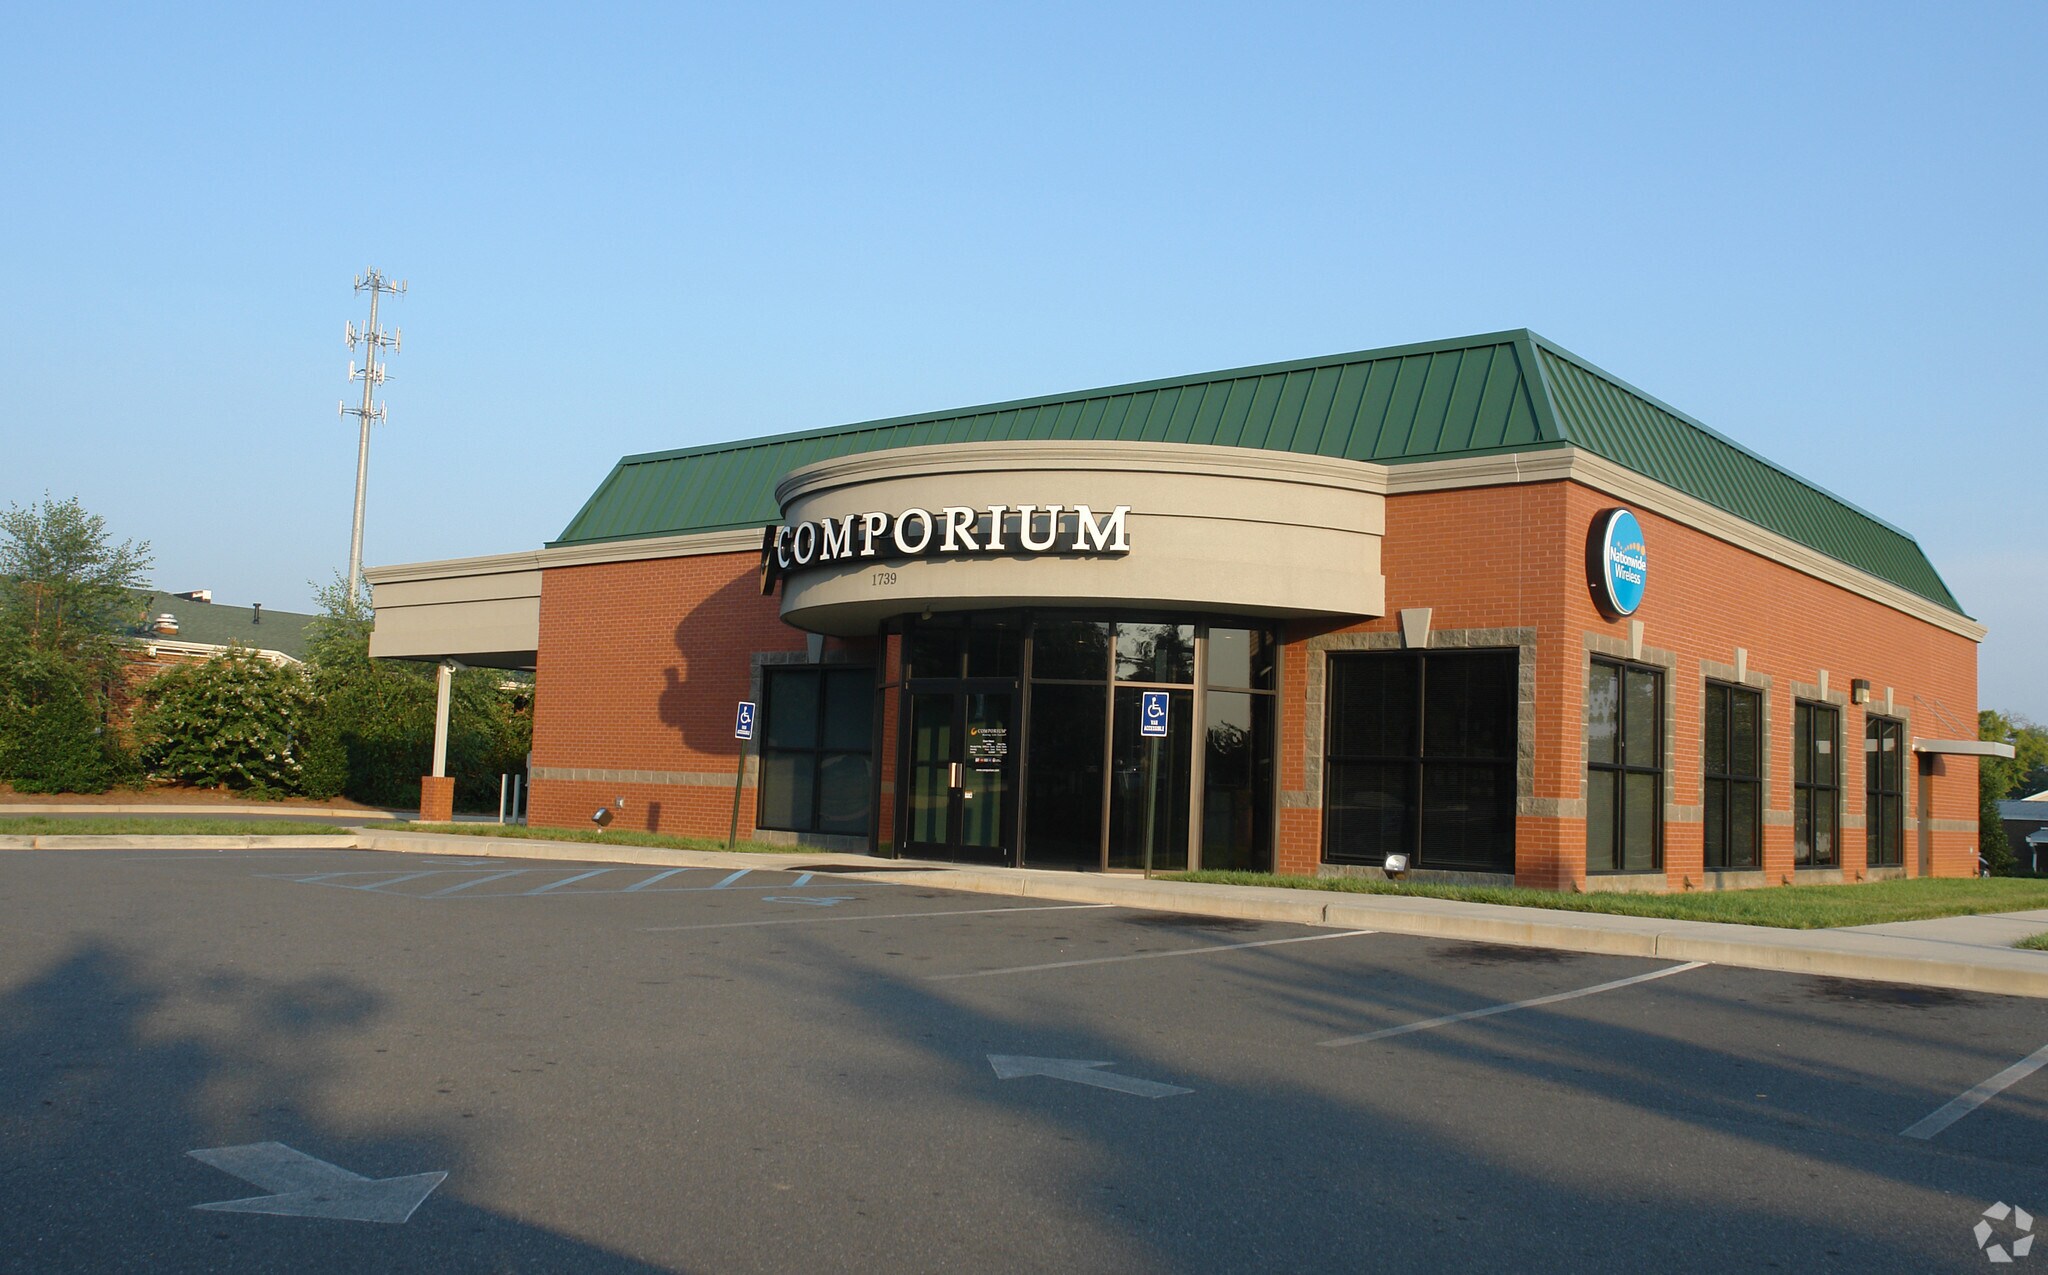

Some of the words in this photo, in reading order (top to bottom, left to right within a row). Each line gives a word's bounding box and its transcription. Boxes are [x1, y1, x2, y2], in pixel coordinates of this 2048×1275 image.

[778, 504, 1131, 568] COMPORIUM
[1610, 546, 1647, 571] Nationwide
[872, 572, 897, 586] 1739
[1615, 563, 1641, 585] Wireless
